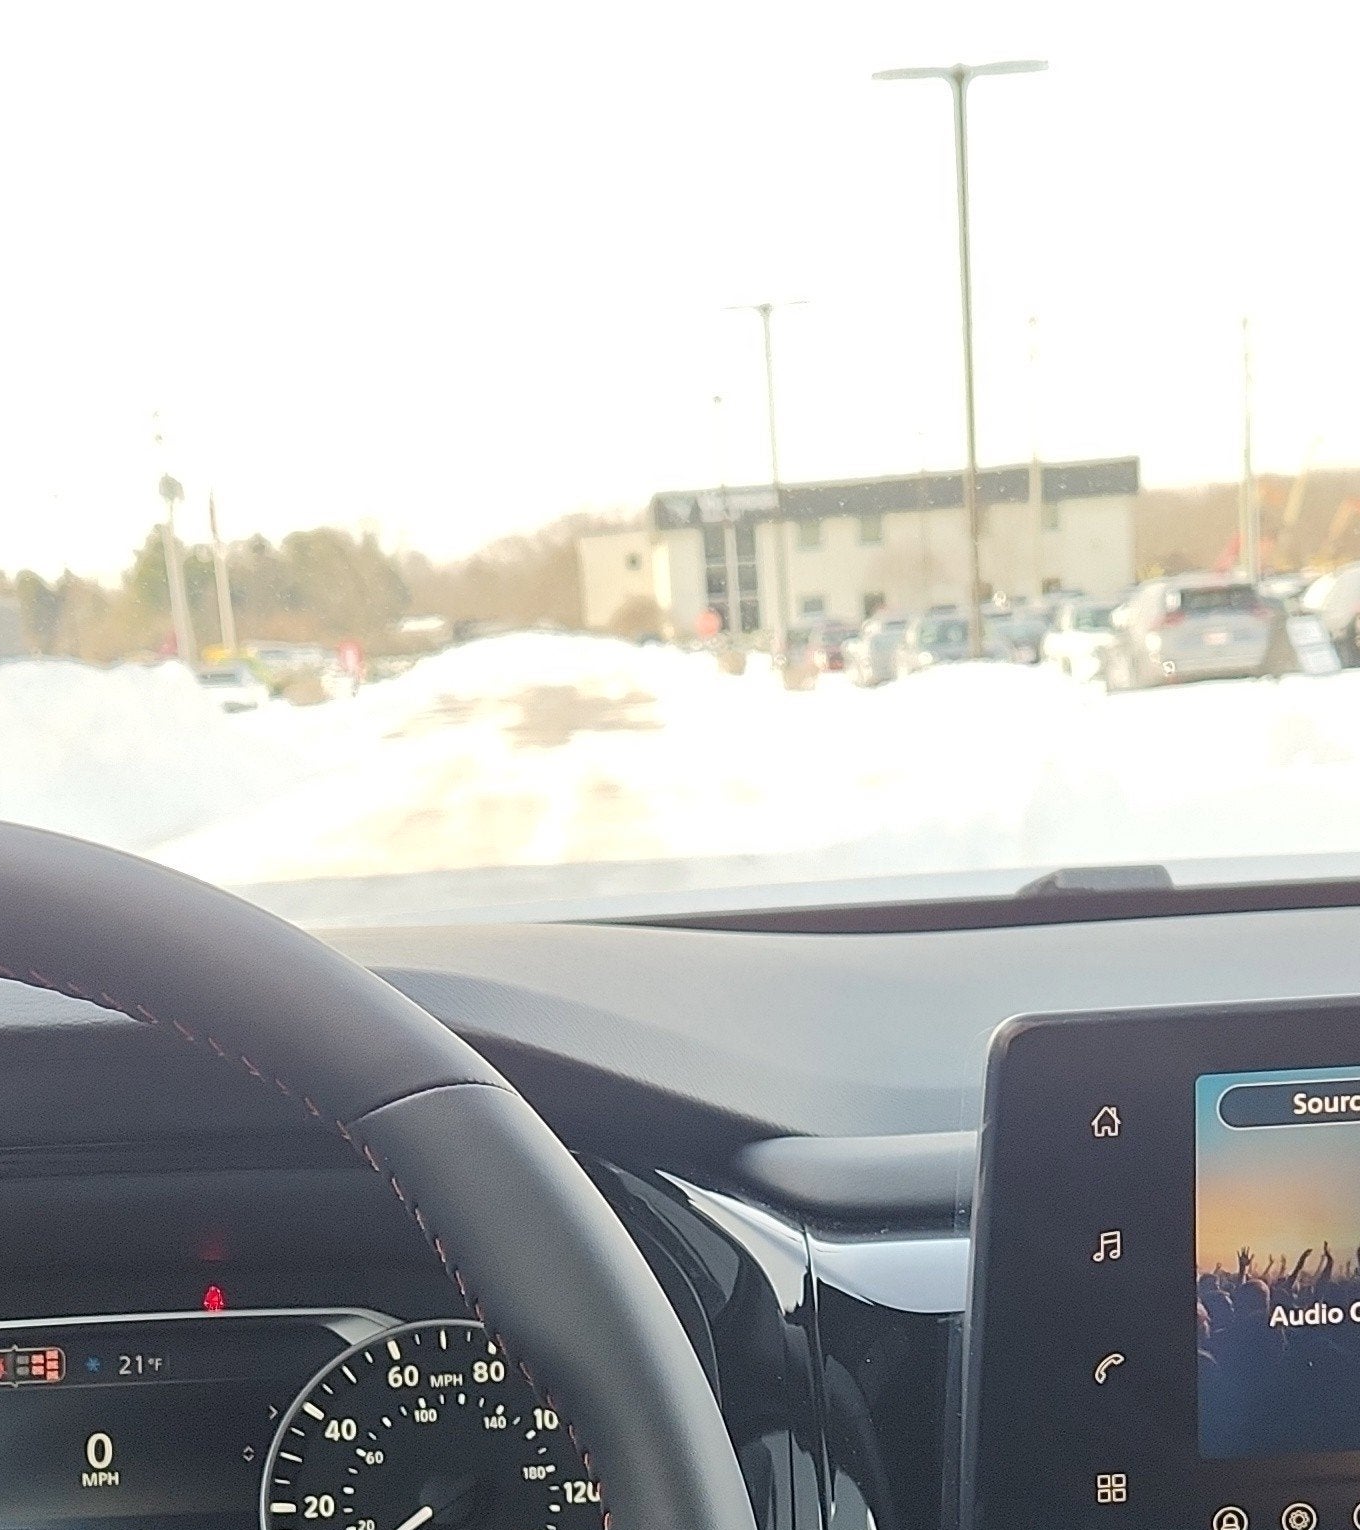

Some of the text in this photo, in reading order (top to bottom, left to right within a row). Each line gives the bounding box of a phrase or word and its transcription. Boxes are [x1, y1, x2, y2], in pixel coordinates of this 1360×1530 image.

[1269, 1302, 1343, 1327] Audio
[387, 1365, 420, 1388] 60
[430, 1373, 463, 1388] MPH
[472, 1360, 505, 1383] 80
[414, 1408, 438, 1423] 100
[483, 1415, 507, 1429] 140
[533, 1408, 559, 1430] 10
[324, 1418, 357, 1441] 40
[86, 1432, 114, 1470] 0
[365, 1450, 384, 1464] 60
[82, 1471, 120, 1487] MPH
[522, 1466, 546, 1479] 180
[303, 1495, 335, 1518] 20
